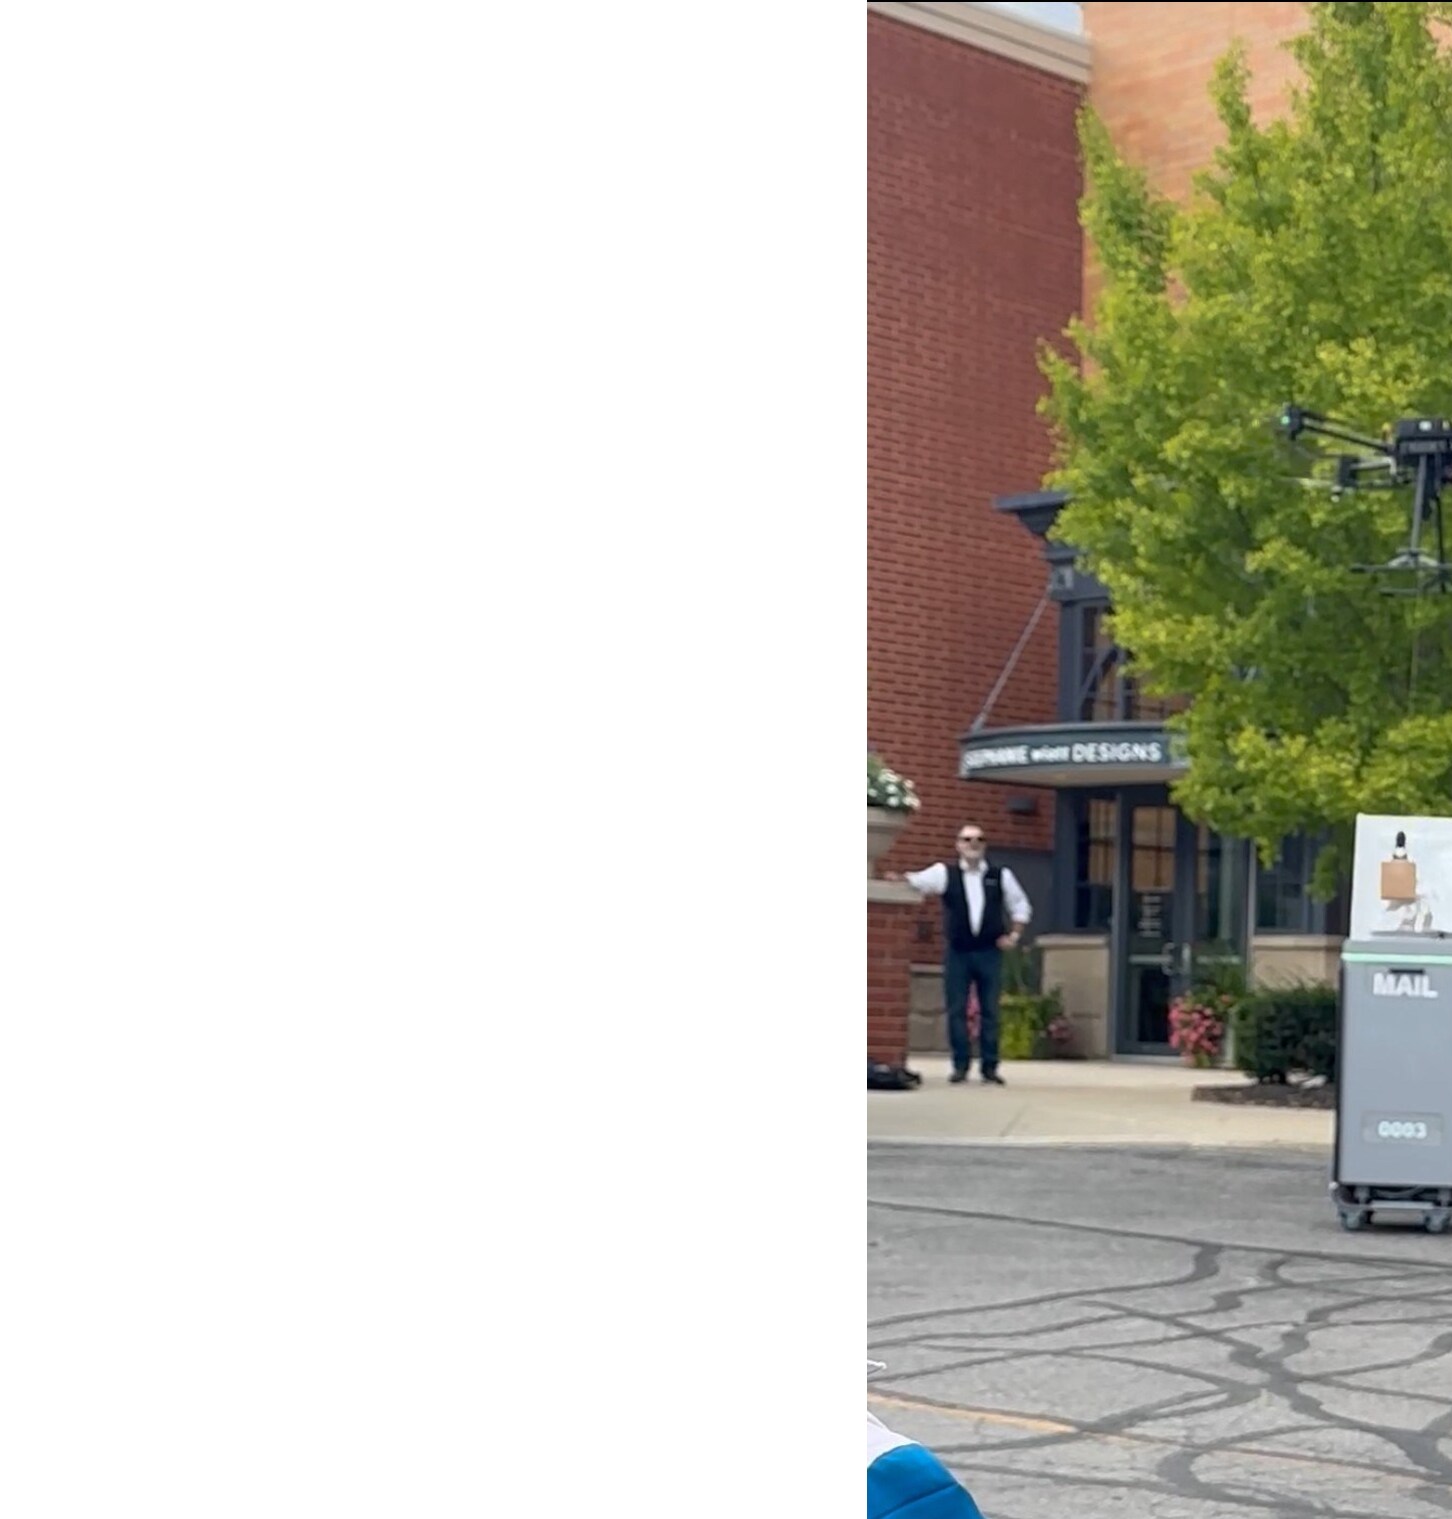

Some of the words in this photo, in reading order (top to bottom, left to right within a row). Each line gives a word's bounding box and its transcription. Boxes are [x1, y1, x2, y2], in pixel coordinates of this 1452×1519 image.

[1072, 742, 1162, 763] DESIGNS
[1373, 972, 1439, 998] MAIL
[1378, 1120, 1427, 1139] 0003
